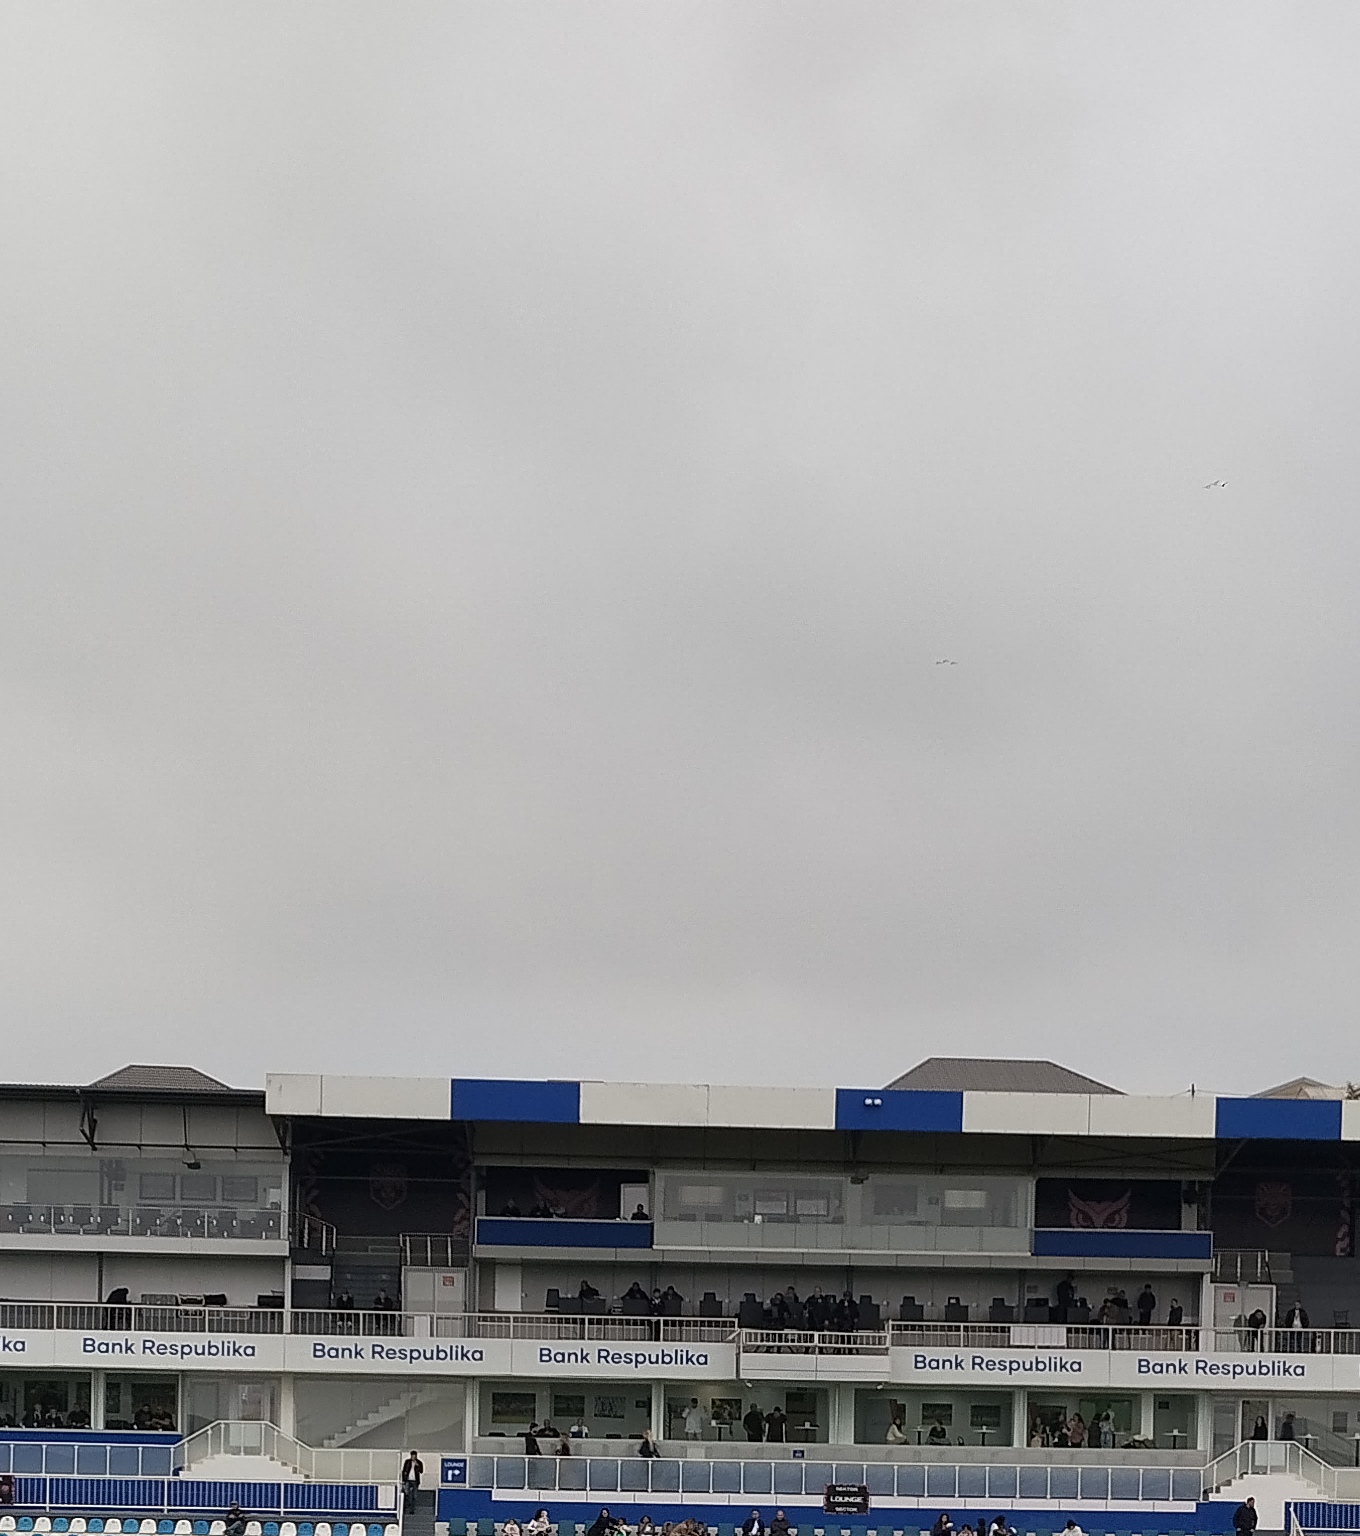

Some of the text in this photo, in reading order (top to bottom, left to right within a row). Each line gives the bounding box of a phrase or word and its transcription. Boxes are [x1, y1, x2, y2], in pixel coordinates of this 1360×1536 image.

[82, 1337, 256, 1361] Bank Respublika
[312, 1342, 484, 1365] Bank Respublika
[539, 1347, 709, 1370] Bank Respublika
[913, 1353, 1082, 1376] Bank Respublika
[1137, 1357, 1306, 1380] Bank Respublika
[830, 1495, 865, 1503] LOUNGE
